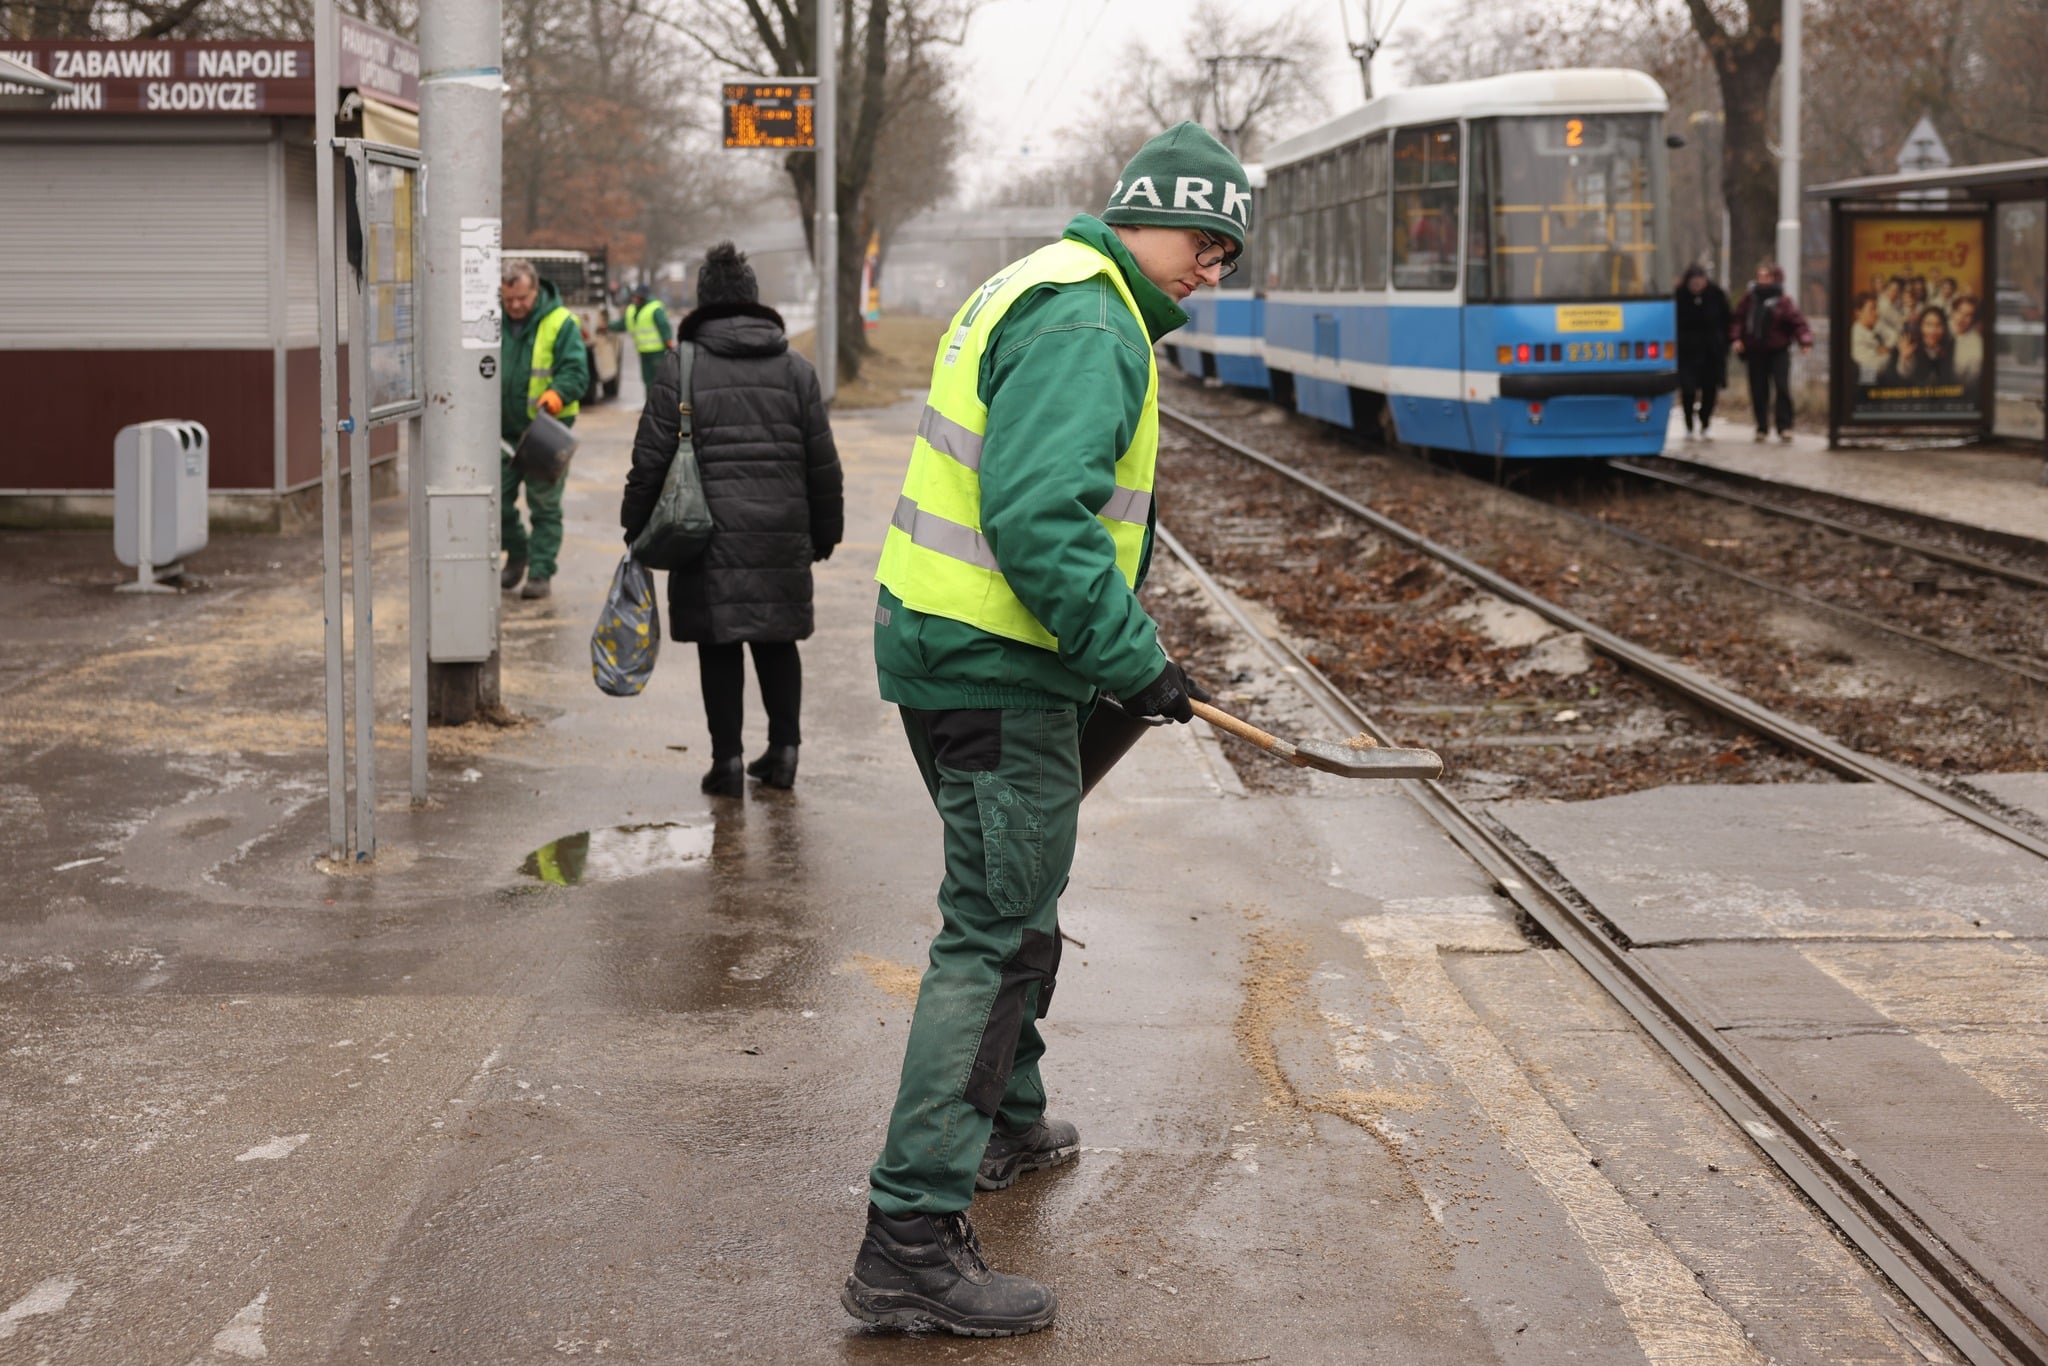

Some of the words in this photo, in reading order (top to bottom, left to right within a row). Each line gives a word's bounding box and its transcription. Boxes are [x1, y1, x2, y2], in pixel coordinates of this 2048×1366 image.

[54, 50, 171, 78] ZABAWKI
[198, 50, 297, 78] NAPOJE
[147, 82, 257, 110] SŁODYCZE
[1566, 119, 1583, 147] 2
